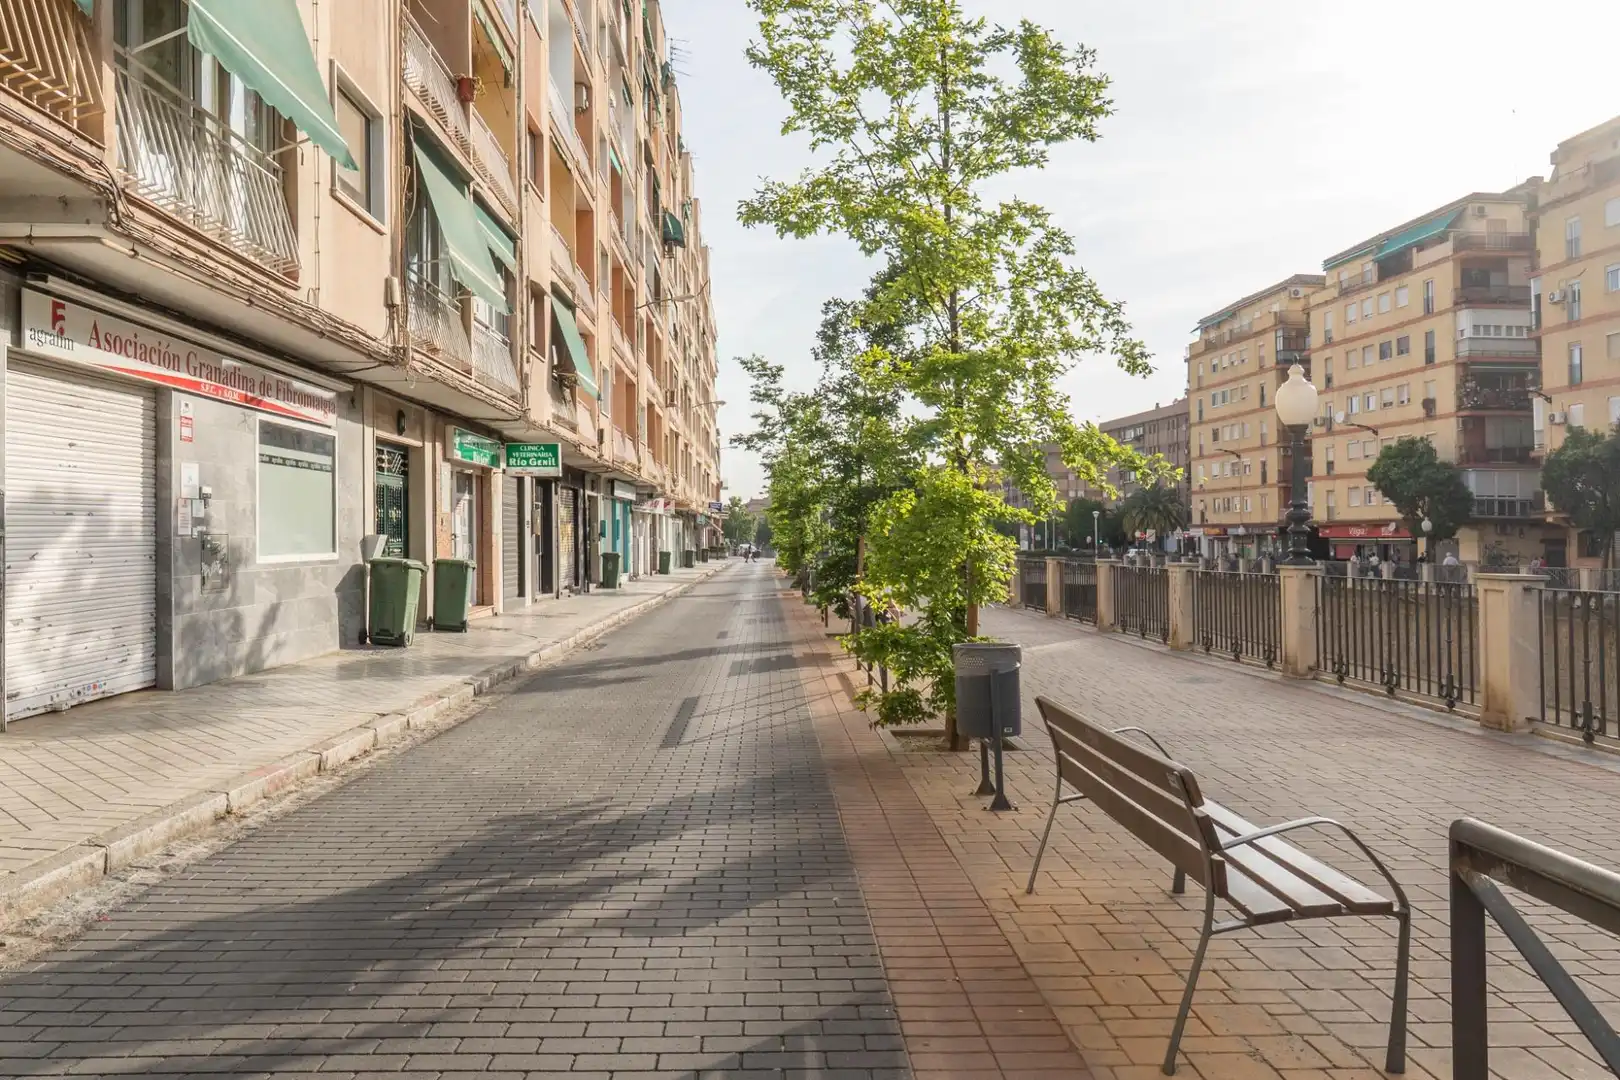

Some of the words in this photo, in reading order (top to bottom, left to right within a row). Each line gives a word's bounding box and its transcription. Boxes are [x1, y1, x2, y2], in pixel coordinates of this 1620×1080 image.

[88, 319, 180, 372] Asociación
[186, 351, 255, 395] Granadina
[259, 375, 272, 398] de
[276, 379, 336, 418] Fibromialgia
[509, 457, 527, 466] Río
